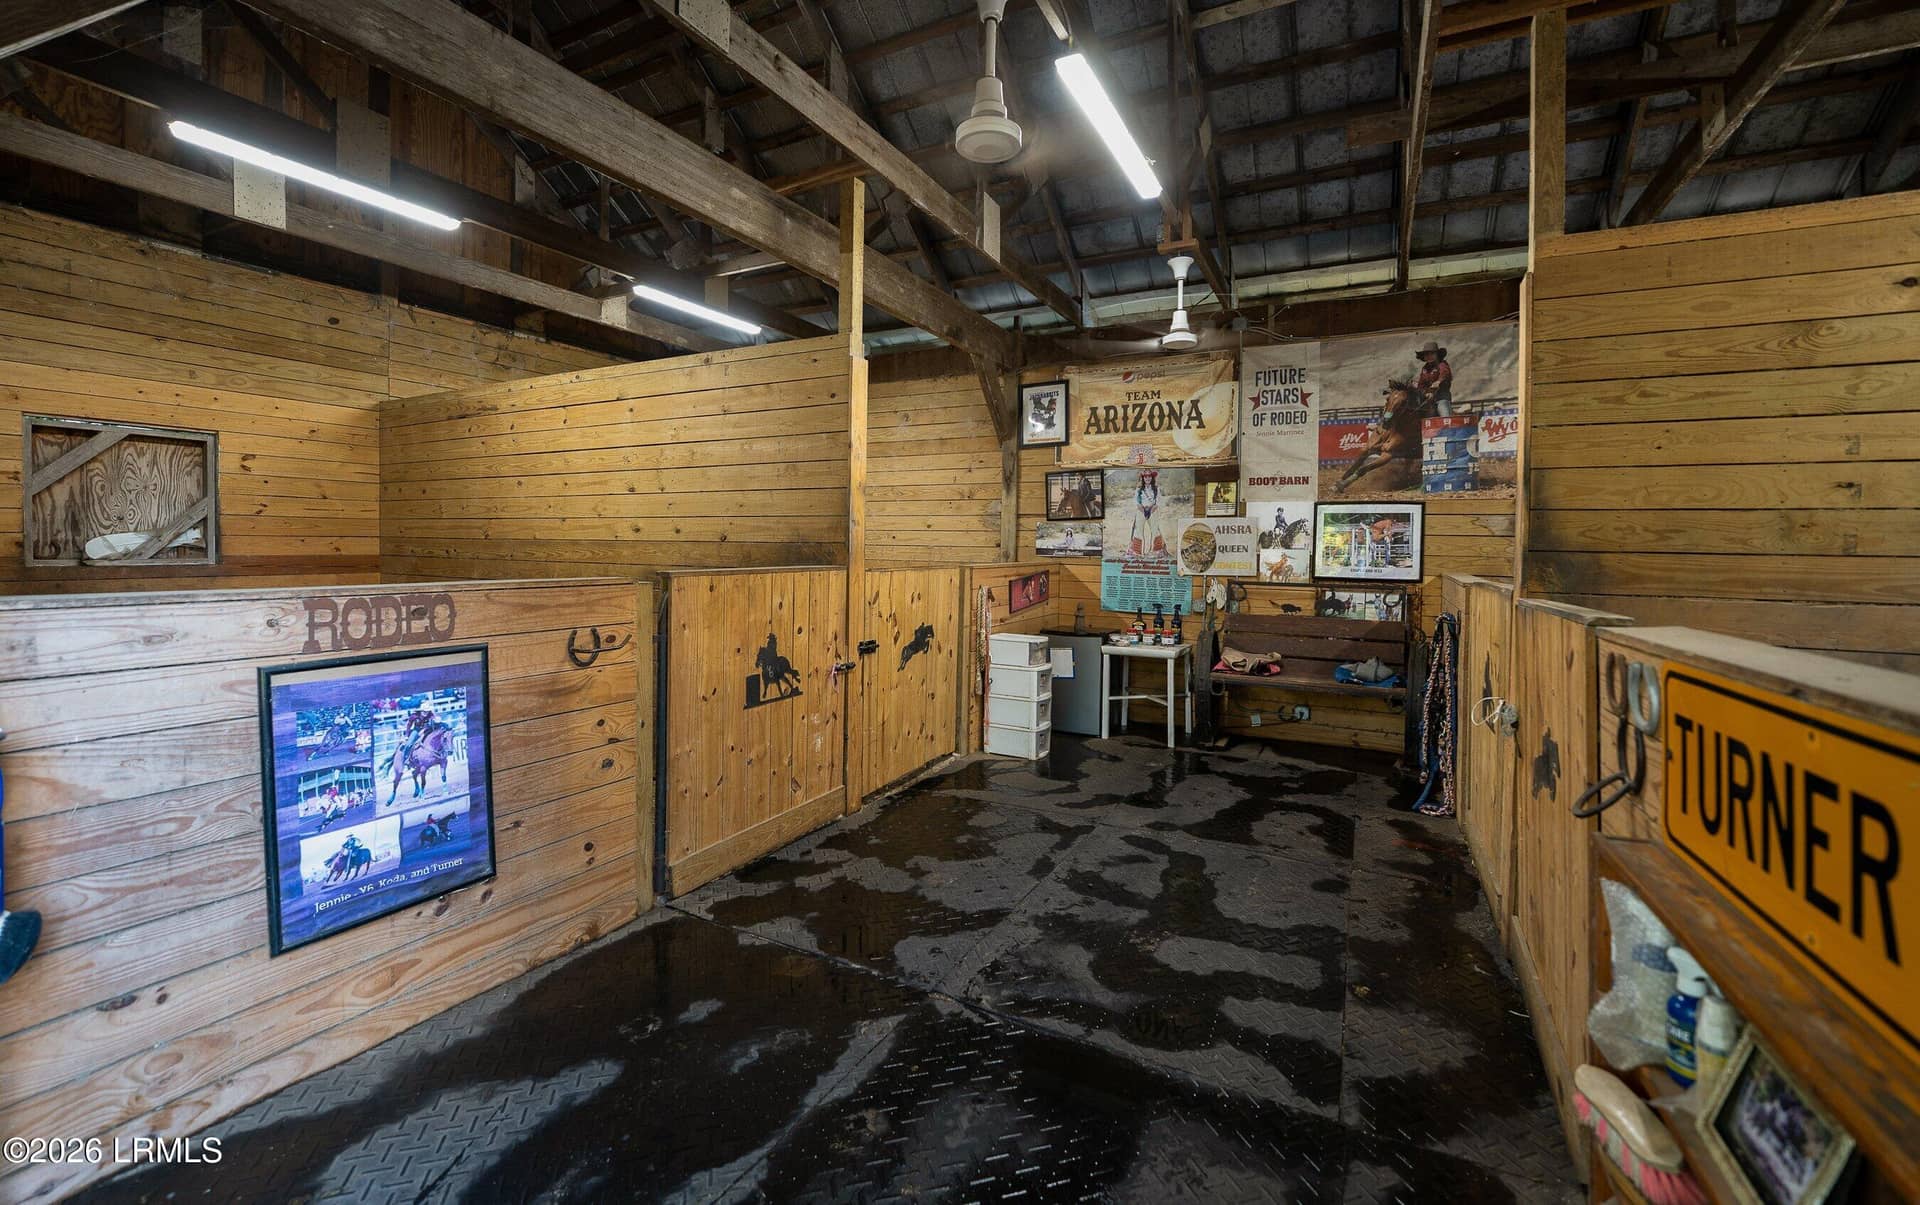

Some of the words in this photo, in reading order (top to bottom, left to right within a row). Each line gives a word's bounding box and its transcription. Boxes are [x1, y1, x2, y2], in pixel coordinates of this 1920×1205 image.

[1136, 370, 1166, 381] pepsi
[1255, 368, 1307, 387] FUTURE
[1126, 390, 1161, 401] TEAM
[1260, 388, 1300, 406] STARS
[1084, 399, 1206, 435] ARIZONA
[1252, 412, 1267, 427] OF
[1270, 410, 1308, 426] RODEO
[1248, 477, 1278, 486] BOOT
[1279, 476, 1310, 485] BARN
[1214, 525, 1252, 535] AHSRA
[1218, 544, 1249, 554] QUEEN
[302, 594, 457, 653] RODEO
[1674, 714, 1903, 968] TURNER
[315, 894, 351, 914] Jennie
[410, 866, 430, 879] and
[431, 857, 464, 873] Turner
